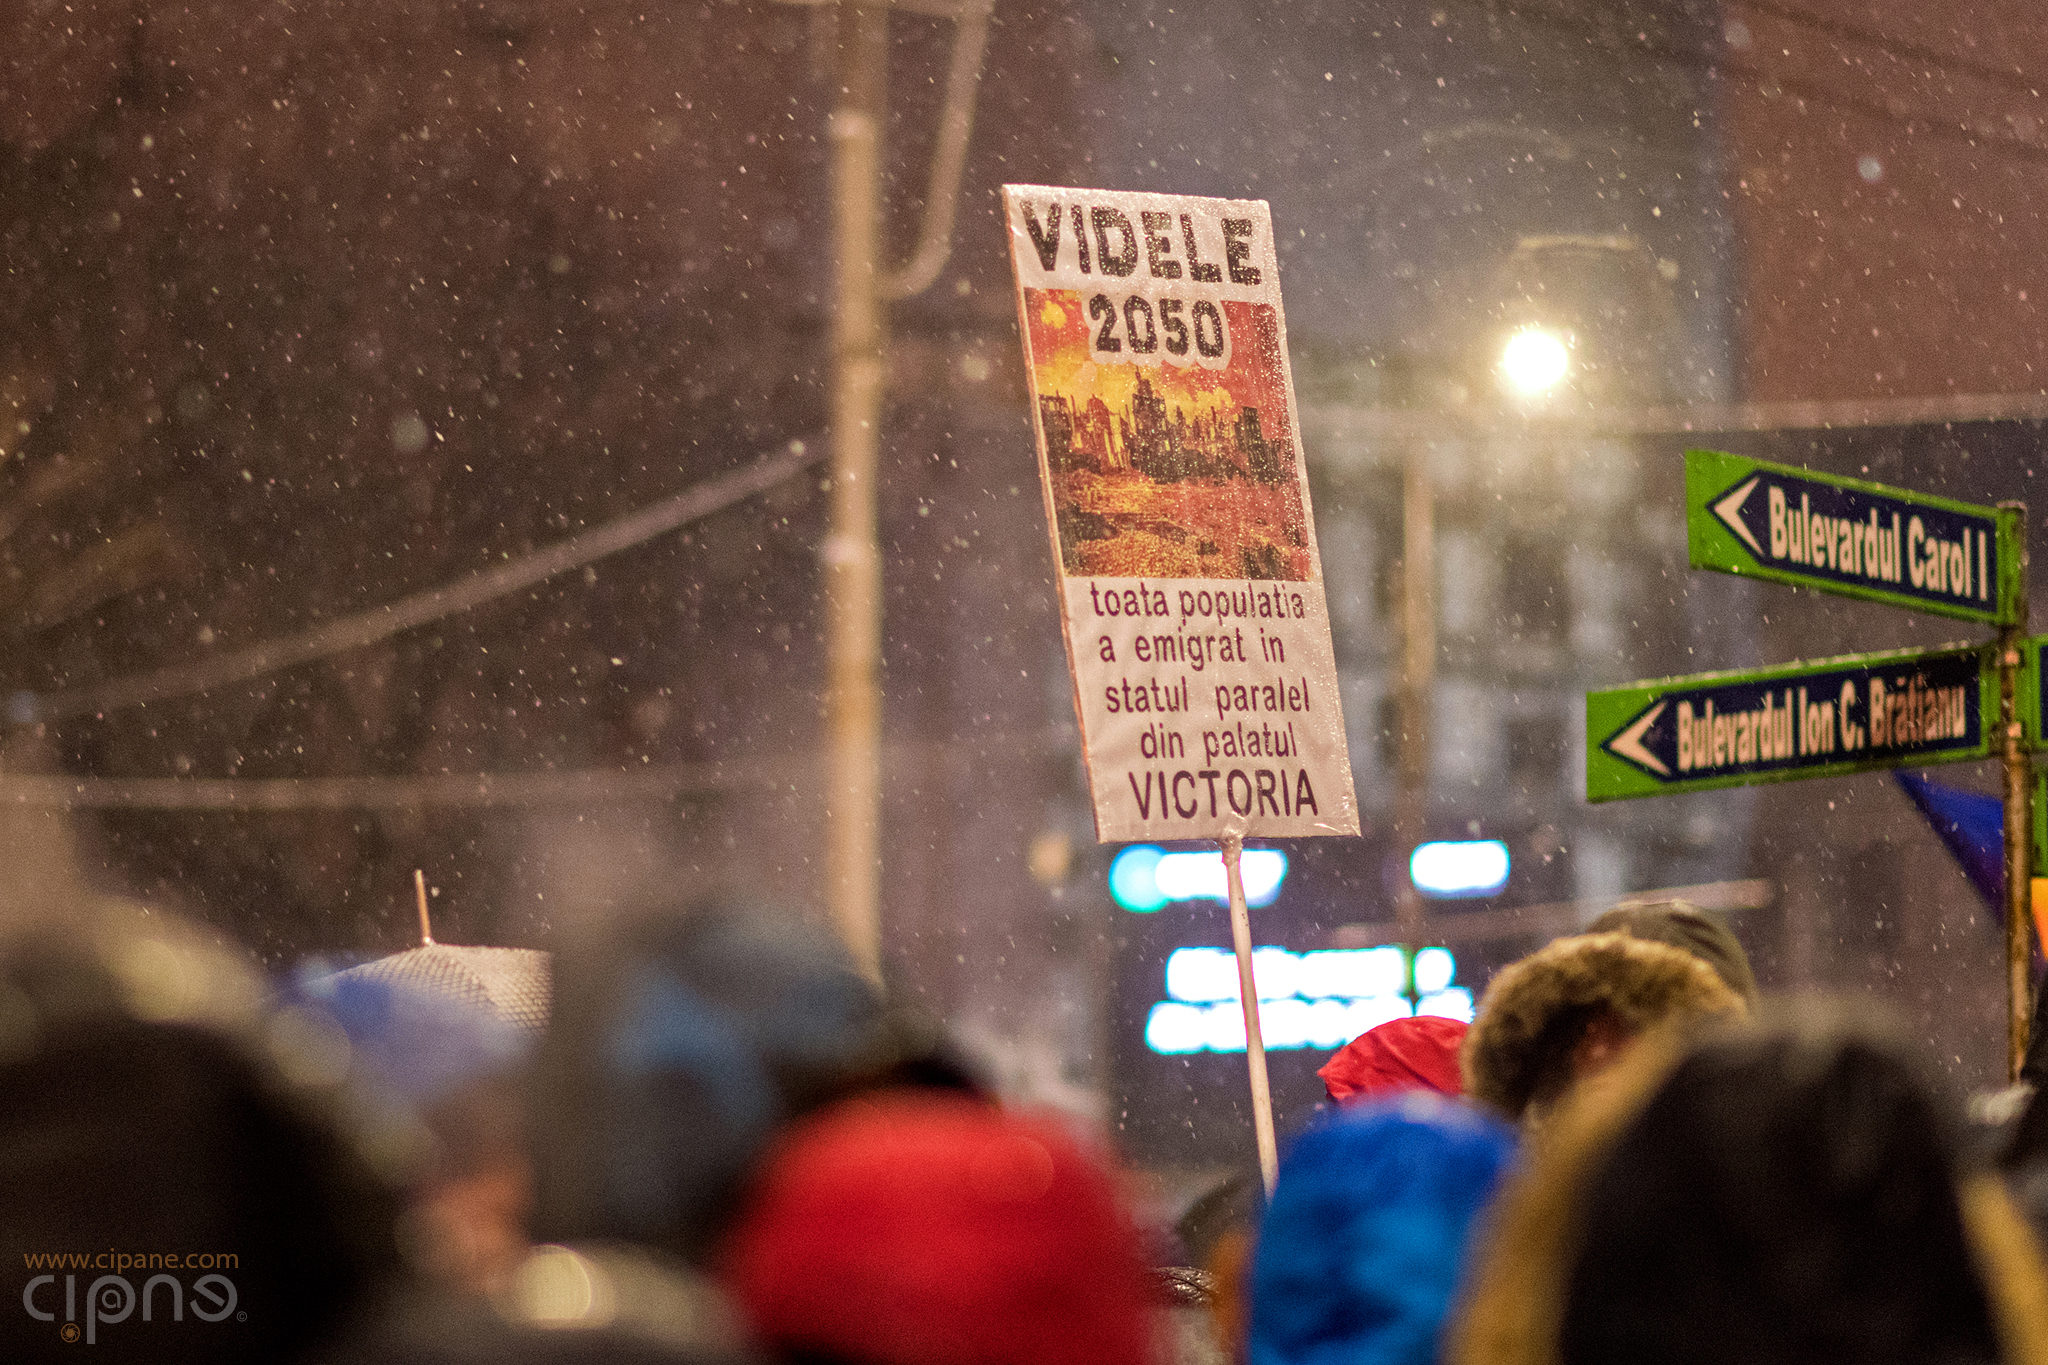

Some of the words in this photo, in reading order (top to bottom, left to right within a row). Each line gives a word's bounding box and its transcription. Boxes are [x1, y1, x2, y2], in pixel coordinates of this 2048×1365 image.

[1020, 200, 1262, 286] VIDELE
[1088, 293, 1225, 358] 2050
[1768, 485, 1902, 584] Bulevardul
[1907, 515, 1973, 599] Carol
[1978, 529, 1988, 601] I
[1090, 582, 1170, 617] toata
[1179, 582, 1306, 626] populatia
[1099, 634, 1116, 663] a
[1135, 626, 1247, 671] emigrat
[1260, 628, 1285, 663] in
[1105, 676, 1189, 713] statul
[1215, 676, 1310, 721] paralel
[1140, 722, 1185, 759] din
[1203, 721, 1298, 767] palatul
[1676, 687, 1794, 772] Bulevardul
[1799, 685, 1835, 757] Ion
[1840, 679, 1865, 751] C.
[1128, 768, 1319, 820] VICTORIA
